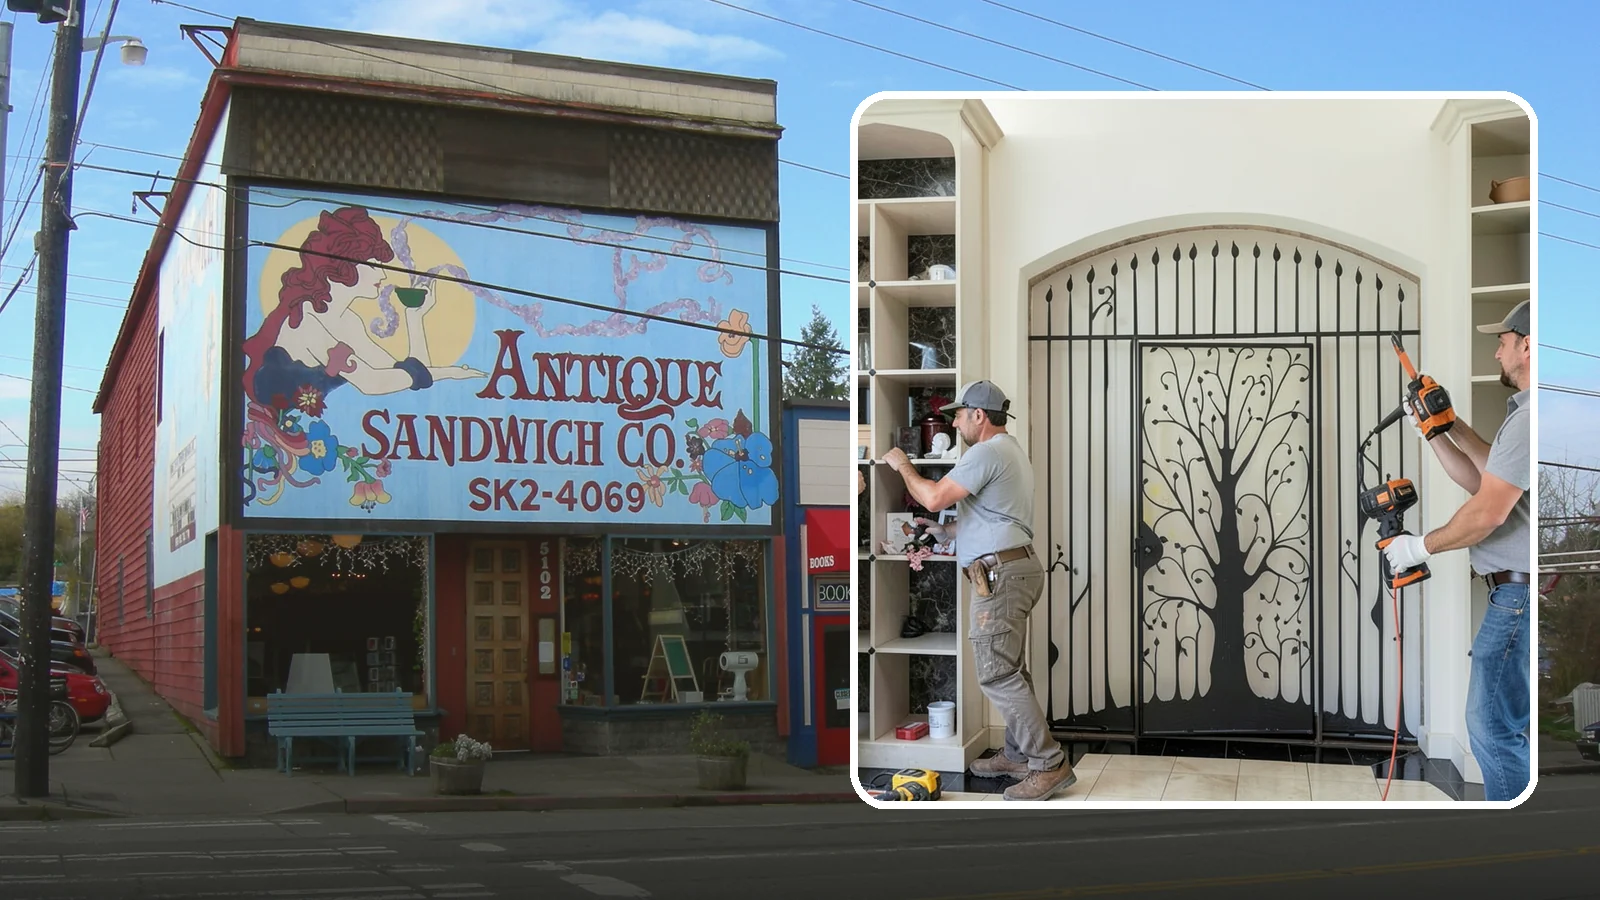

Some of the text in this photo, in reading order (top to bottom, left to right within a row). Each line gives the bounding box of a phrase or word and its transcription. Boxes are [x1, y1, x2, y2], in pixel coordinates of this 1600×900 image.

[475, 328, 724, 421] ANTIQUE
[361, 408, 685, 470] SANDWICH CO.
[468, 477, 646, 513] SK2-4069
[539, 541, 552, 600] 5102
[809, 554, 835, 569] BOOKS
